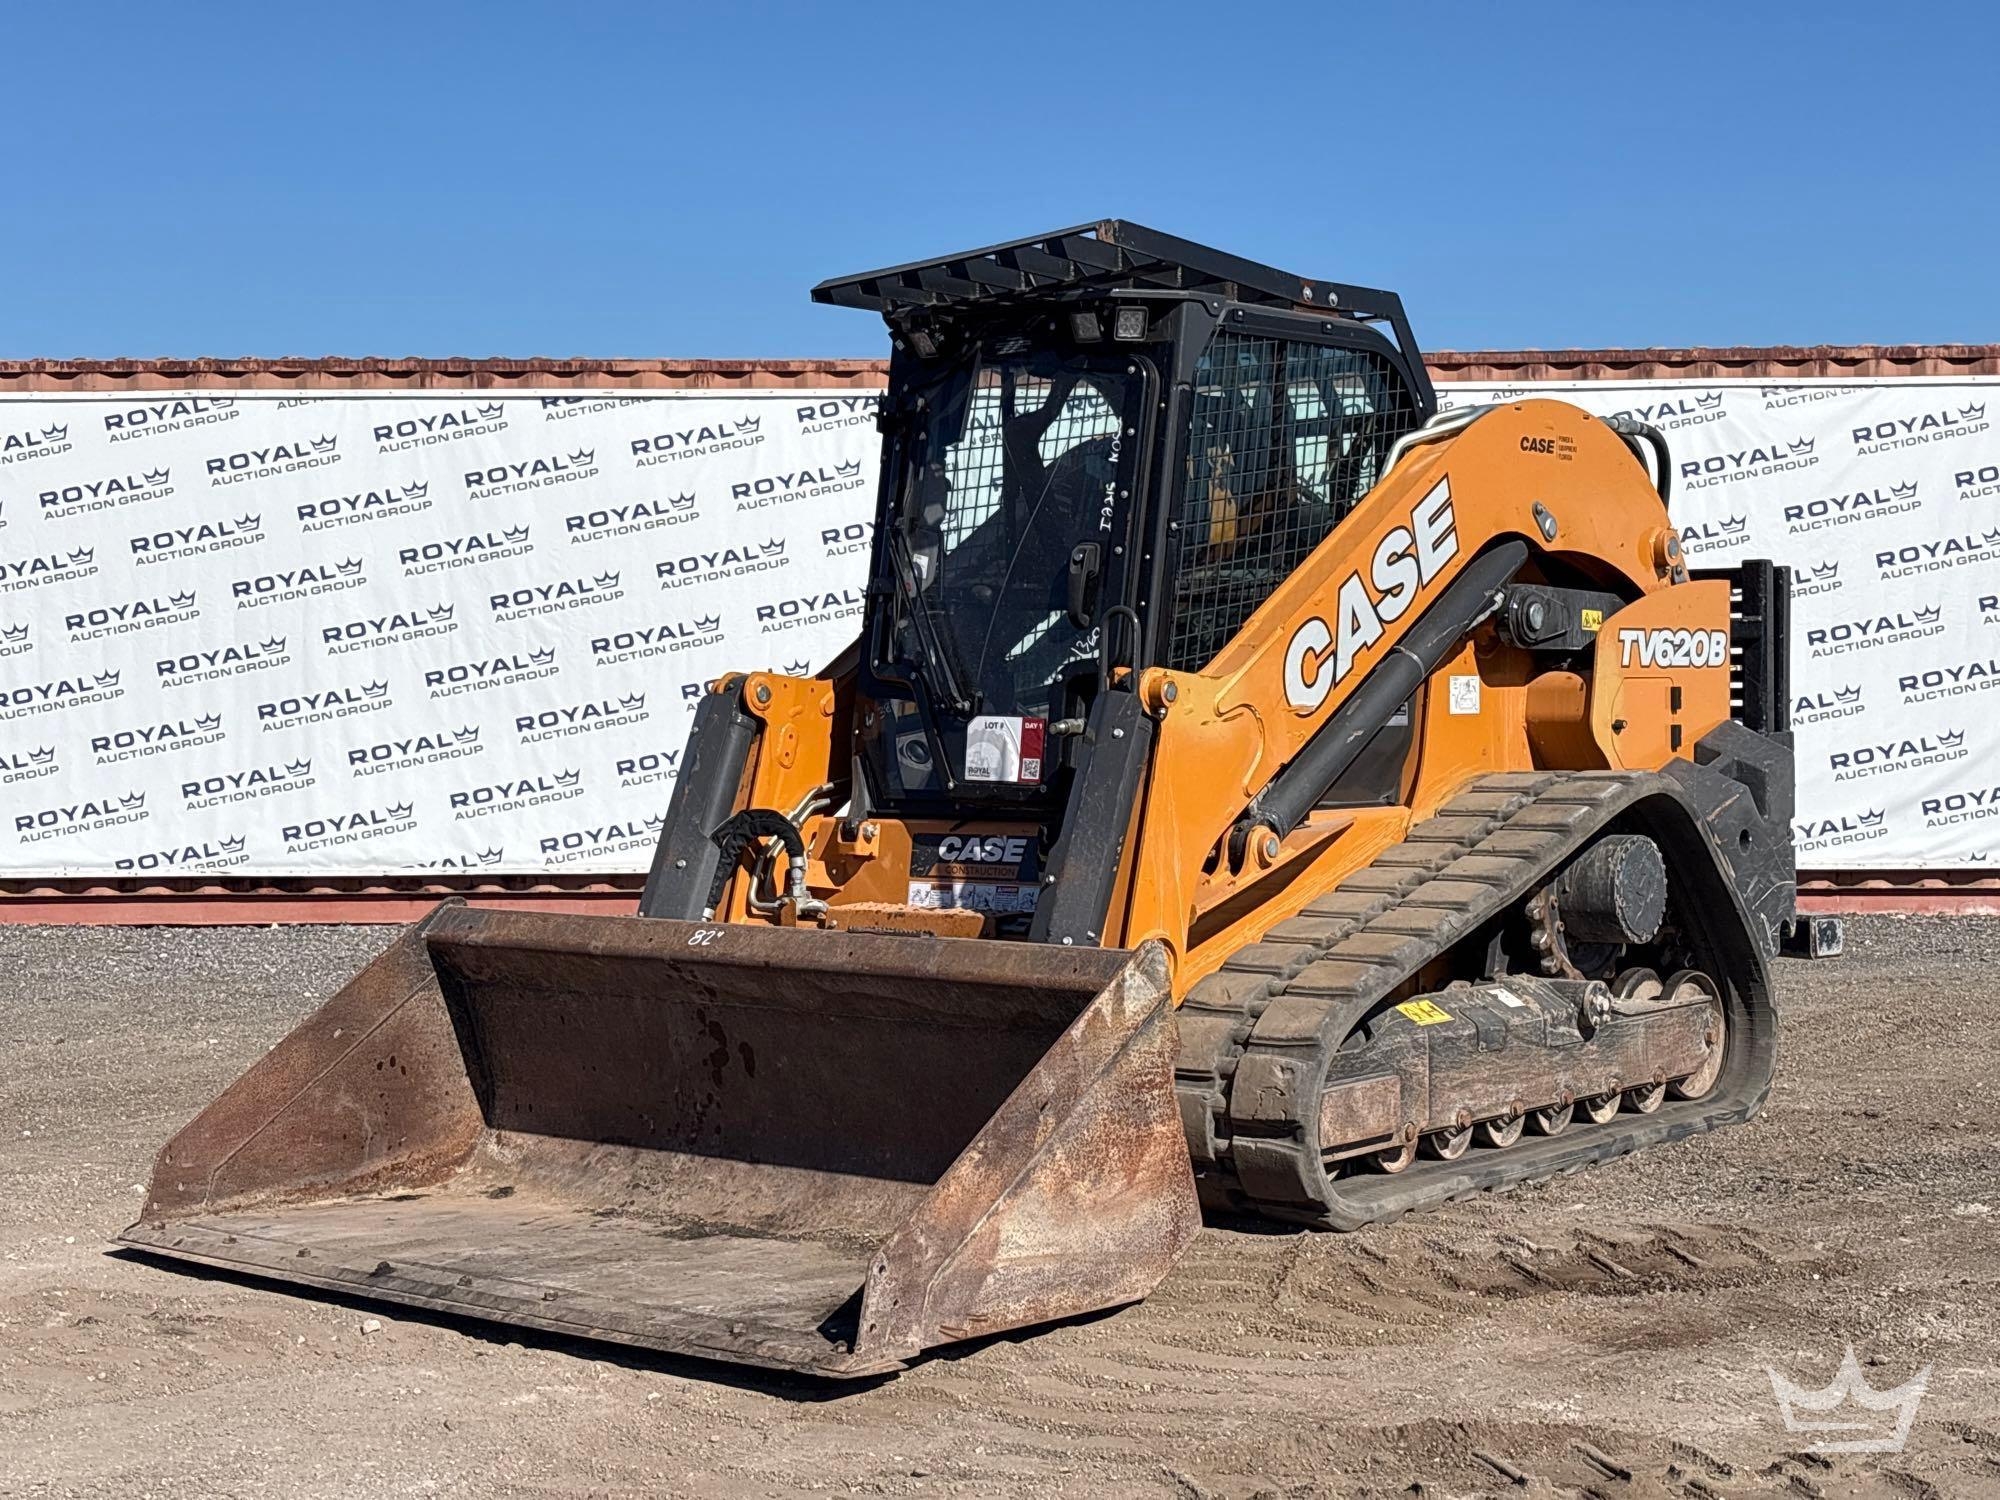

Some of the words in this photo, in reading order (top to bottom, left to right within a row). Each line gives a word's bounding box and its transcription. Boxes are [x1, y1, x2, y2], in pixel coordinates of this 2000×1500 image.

[104, 398, 207, 430] ROYAL
[546, 401, 616, 421] AUCTION
[797, 397, 880, 423] ROYA
[1765, 390, 1837, 410] AUCTION
[110, 422, 180, 443] AUCTION
[184, 410, 239, 428] GROUP
[374, 410, 478, 442] ROYAL
[1669, 411, 1727, 430] GROUP
[1852, 411, 1959, 444] ROYAL
[16, 444, 72, 461] GROUP
[379, 433, 449, 454] AUCTION
[453, 422, 508, 439] GROUP
[631, 424, 734, 456] ROYAL
[636, 447, 706, 468] AUCTION
[710, 436, 764, 453] GROUP
[1520, 436, 1555, 454] CASE
[1858, 434, 1929, 456] AUCTION
[1933, 423, 1989, 440] GROUP
[206, 443, 311, 475] ROYAL
[212, 466, 282, 487] AUCTION
[286, 454, 341, 472] GROUP
[464, 456, 568, 488] ROYAL
[1681, 445, 1788, 478] ROYAL
[1686, 469, 1758, 490] AUCTION
[1762, 457, 1819, 475] GROUP
[39, 476, 144, 508] ROYAL
[470, 480, 540, 500] AUCTION
[544, 468, 598, 485] GROUP
[732, 468, 835, 500] ROYAL
[737, 490, 806, 511] AUCTION
[810, 479, 864, 496] GROUP
[44, 499, 115, 520] AUCTION
[118, 488, 174, 505] GROUP
[297, 489, 402, 520] ROYAL
[302, 512, 373, 533] AUCTION
[376, 501, 432, 518] GROUP
[566, 500, 670, 532] ROYAL
[1784, 489, 1891, 522] ROYAL
[1789, 513, 1861, 534] AUCTION
[1865, 501, 1921, 519] GROUP
[130, 522, 235, 554] ROYAL
[571, 524, 641, 544] AUCTION
[644, 512, 700, 530] GROUP
[1693, 535, 1750, 553] GROUP
[136, 545, 206, 566] AUCTION
[210, 534, 265, 551] GROUP
[399, 533, 504, 565] ROYAL
[405, 556, 475, 576] AUCTION
[478, 545, 534, 562] GROUP
[656, 546, 760, 578] ROYAL
[1876, 536, 1982, 568] ROYAL
[1881, 559, 1952, 580] AUCTION
[1956, 549, 2000, 565] GROU
[1, 578, 39, 592] TION
[43, 566, 98, 584] GROUP
[232, 566, 336, 598] ROYAL
[662, 569, 731, 590] AUCTION
[734, 558, 789, 575] GROUP
[238, 589, 307, 610] AUCTION
[311, 578, 366, 594] GROUP
[490, 579, 594, 611] ROYAL
[496, 602, 565, 622] AUCTION
[569, 591, 624, 608] GROUP
[756, 590, 859, 622] ROYAL
[1283, 472, 1459, 717] CASE
[65, 599, 170, 631] ROYAL
[71, 622, 141, 643] AUCTION
[144, 610, 200, 628] GROUP
[322, 612, 428, 643] ROYAL
[762, 613, 831, 634] AUCTION
[1807, 614, 1914, 646] ROYAL
[0, 644, 33, 656] OUP
[328, 634, 398, 656] AUCTION
[402, 623, 458, 640] GROUP
[591, 622, 694, 654] ROYAL
[596, 646, 666, 666] AUCTION
[670, 634, 724, 651] GROUP
[1618, 628, 1727, 669] TV620B
[1812, 637, 1884, 658] AUCTION
[1888, 625, 1944, 643] GROUP
[156, 644, 260, 676] ROYAL
[162, 668, 232, 688] AUCTION
[235, 656, 290, 674] GROUP
[425, 655, 529, 687] ROYAL
[69, 689, 124, 706] GROUP
[430, 678, 500, 699] AUCTION
[504, 667, 559, 684] GROUP
[1904, 683, 1976, 704] AUCTION
[258, 688, 362, 720] ROYAL
[263, 711, 332, 732] AUCTION
[336, 700, 392, 717] GROUP
[516, 701, 619, 732] ROYAL
[1808, 705, 1865, 722] GROUP
[91, 721, 195, 753] ROYAL
[521, 724, 591, 744] AUCTION
[594, 712, 649, 730] GROUP
[985, 721, 998, 730] LOT
[1025, 722, 1037, 730] DAY
[96, 744, 166, 765] AUCTION
[170, 733, 225, 750] GROUP
[348, 734, 453, 766] ROYAL
[353, 756, 424, 778] AUCTION
[428, 745, 483, 762] GROUP
[616, 750, 679, 776] ROY
[1830, 738, 1937, 770] ROYAL
[3, 766, 59, 783] GROUP
[622, 769, 679, 788] AUCTIO
[1835, 761, 1907, 782] AUCTION
[1911, 750, 1968, 767] GROUP
[182, 767, 286, 798] ROYAL
[187, 790, 256, 810] AUCTION
[260, 778, 315, 796] GROUP
[450, 777, 554, 808] ROYAL
[15, 800, 119, 832] ROYAL
[455, 800, 525, 820] AUCTION
[529, 788, 584, 806] GROUP
[1927, 807, 1998, 828] AUCTION
[20, 822, 90, 844] AUCTION
[94, 811, 149, 828] GROUP
[282, 810, 387, 842] ROYAL
[287, 833, 358, 854] AUCTION
[362, 822, 417, 839] GROUP
[540, 822, 644, 854] ROYAL
[1798, 817, 1857, 838] YAL
[1831, 828, 1888, 845] GROUP
[545, 845, 614, 865] AUCTION
[939, 837, 1027, 862] CASE
[945, 866, 1015, 876] CONSTRUCTION
